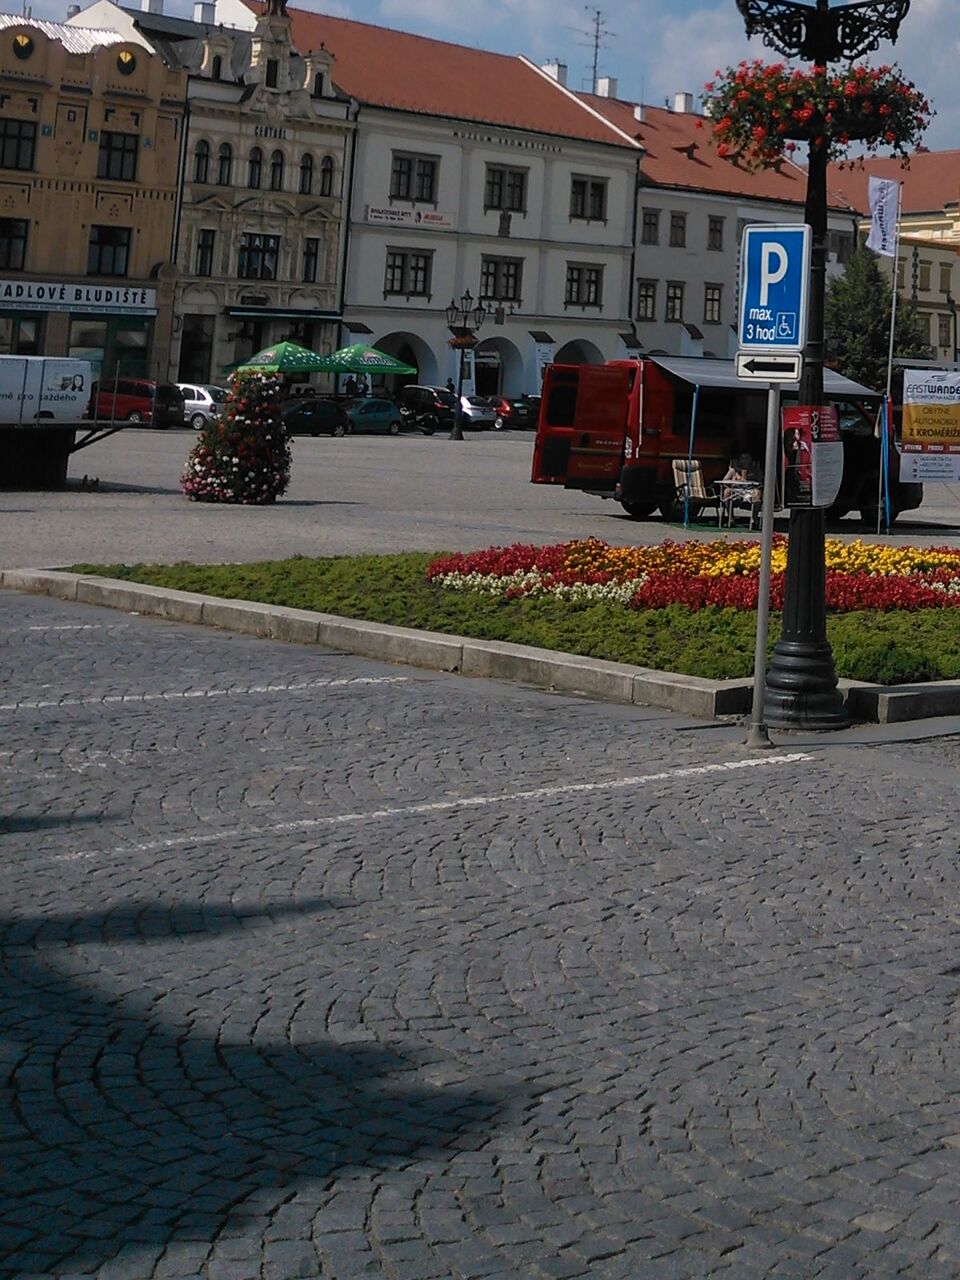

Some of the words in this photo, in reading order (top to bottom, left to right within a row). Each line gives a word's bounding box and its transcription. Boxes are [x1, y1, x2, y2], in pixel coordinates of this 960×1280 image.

[759, 242, 789, 306] P
[0, 283, 66, 300] ADLOVÉ
[74, 288, 147, 304] BLUDIŠTĚ
[749, 307, 774, 321] max.
[746, 323, 753, 339] 3
[756, 323, 775, 340] hod
[908, 428, 914, 437] Z
